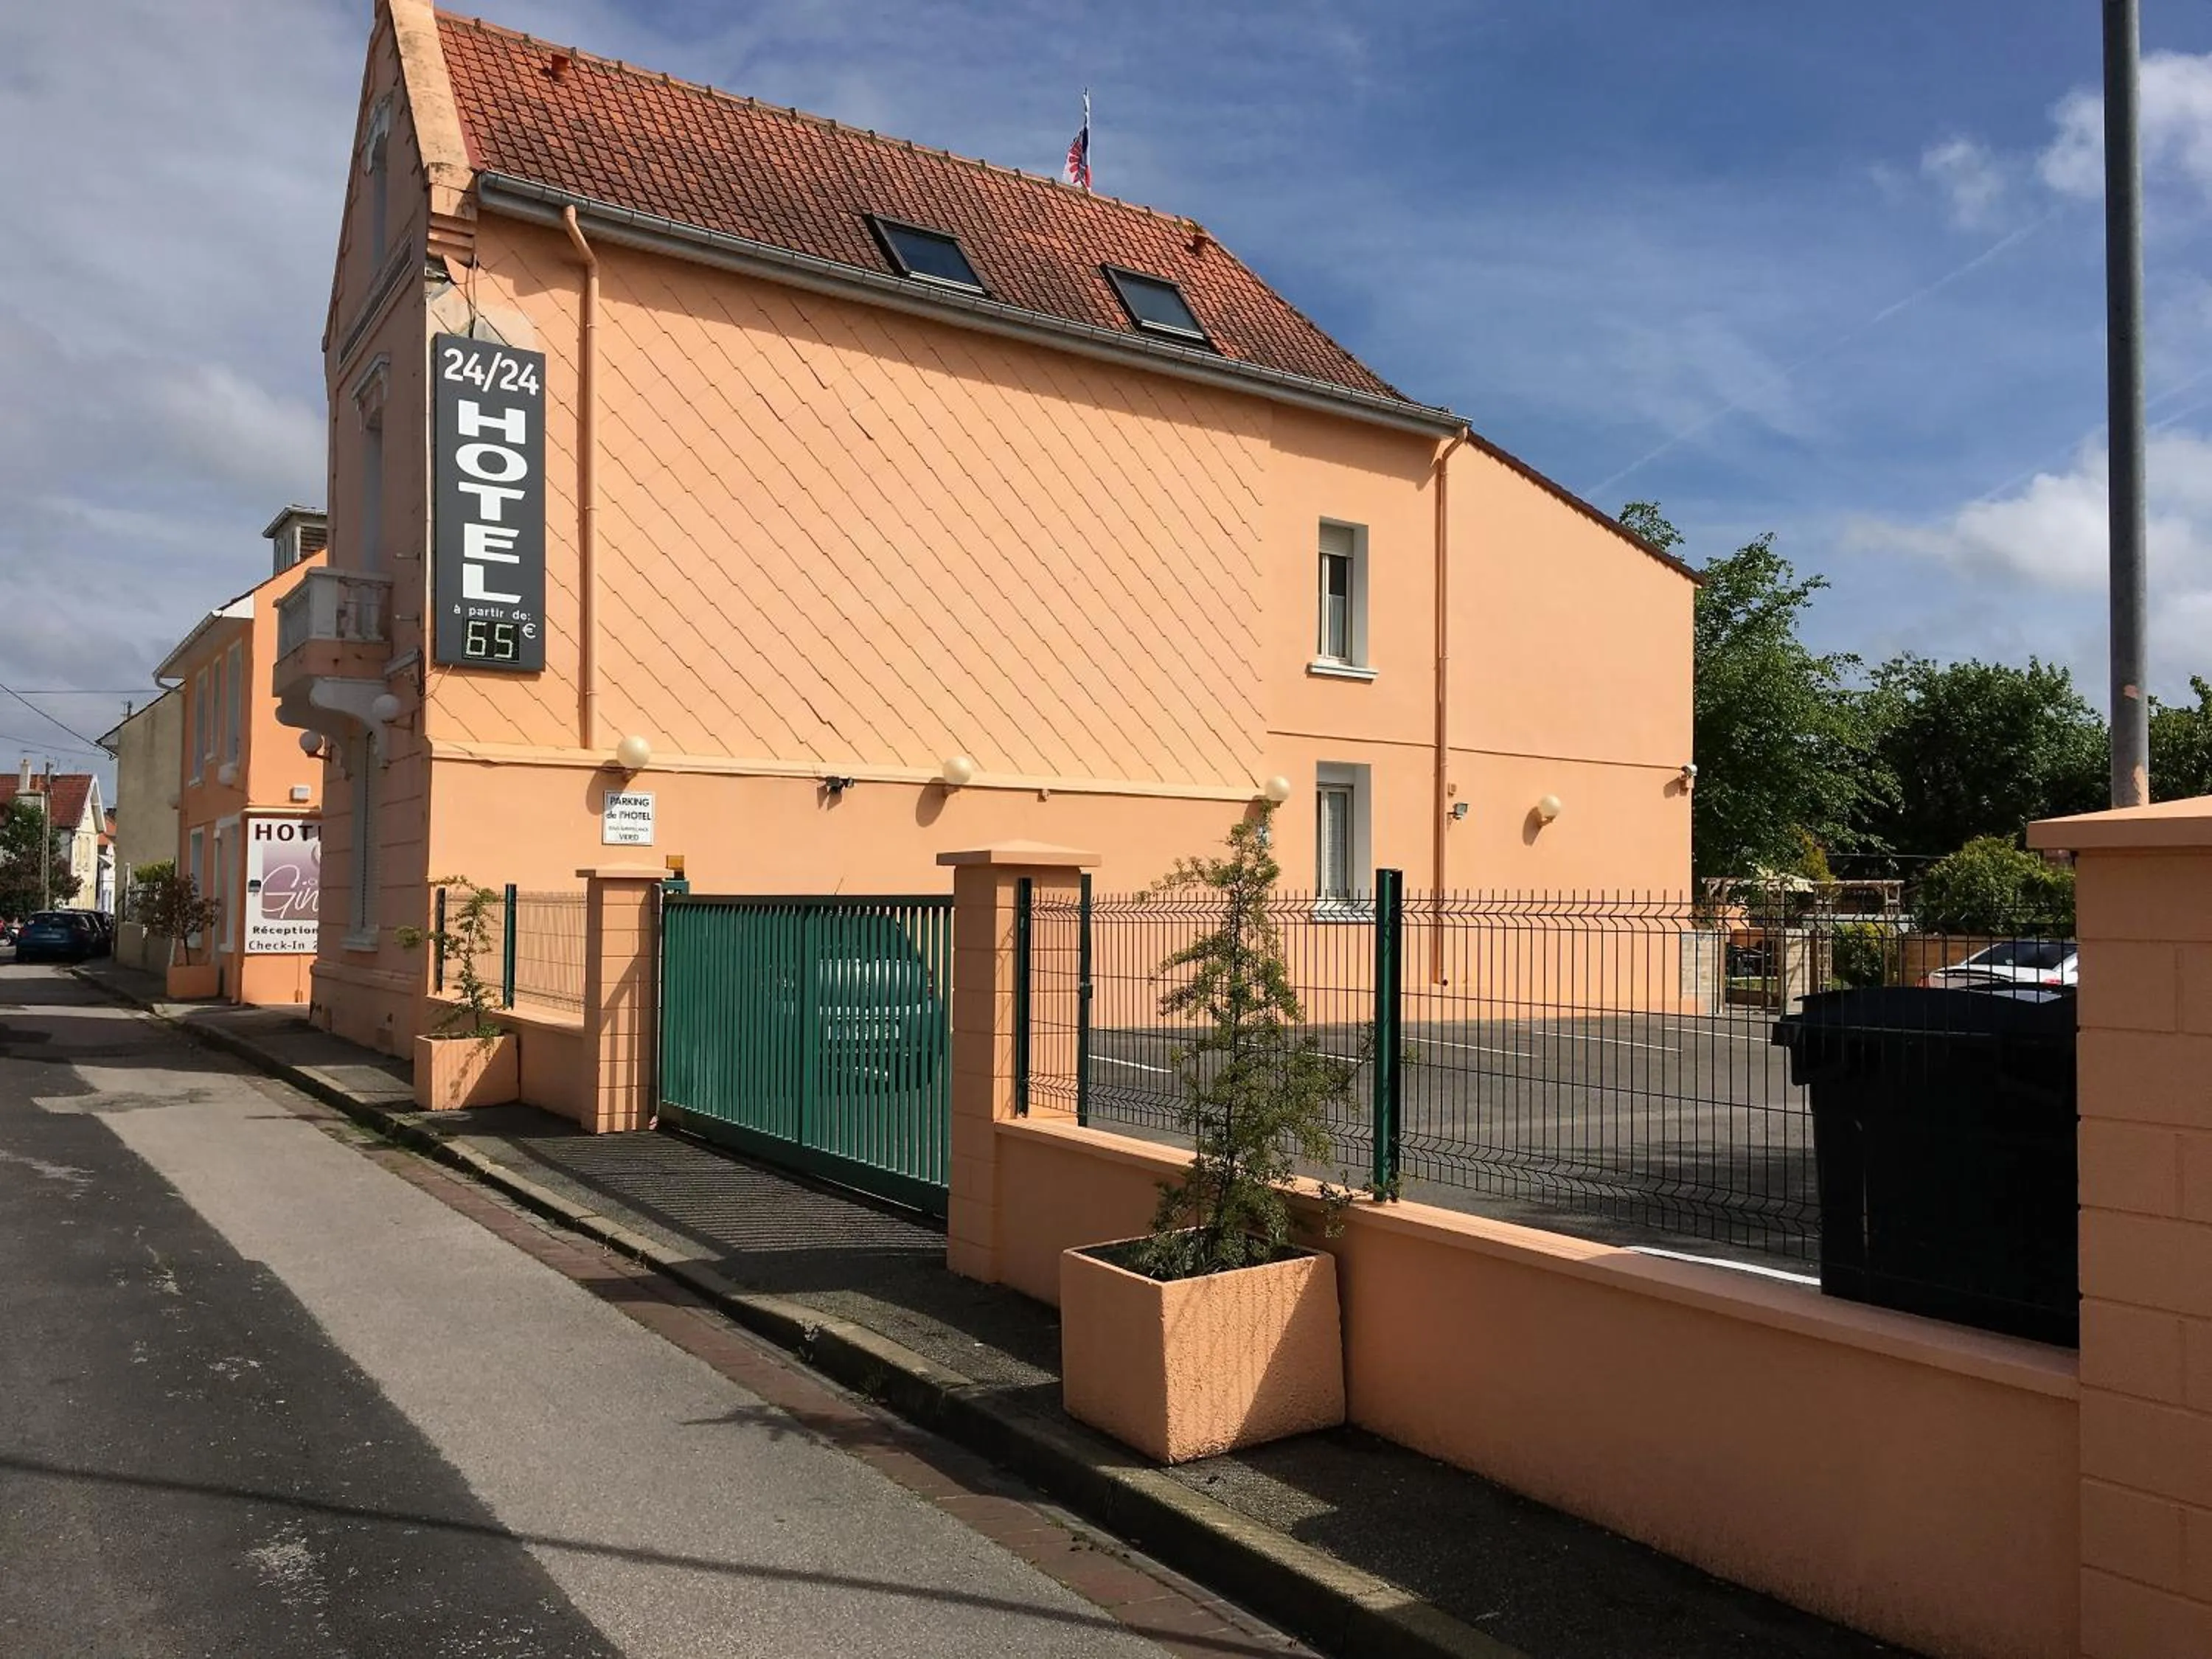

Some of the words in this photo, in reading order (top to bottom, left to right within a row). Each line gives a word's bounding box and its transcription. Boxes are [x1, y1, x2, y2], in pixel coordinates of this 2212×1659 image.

[444, 348, 539, 396] 24/24
[455, 399, 528, 603] HOTEL
[453, 605, 461, 615] à
[468, 605, 504, 619] partir
[466, 621, 514, 658] 65
[522, 623, 536, 639] €
[610, 796, 650, 807] PARKING
[607, 811, 617, 819] de
[255, 824, 321, 841] HOT
[248, 940, 305, 950] Check-In
